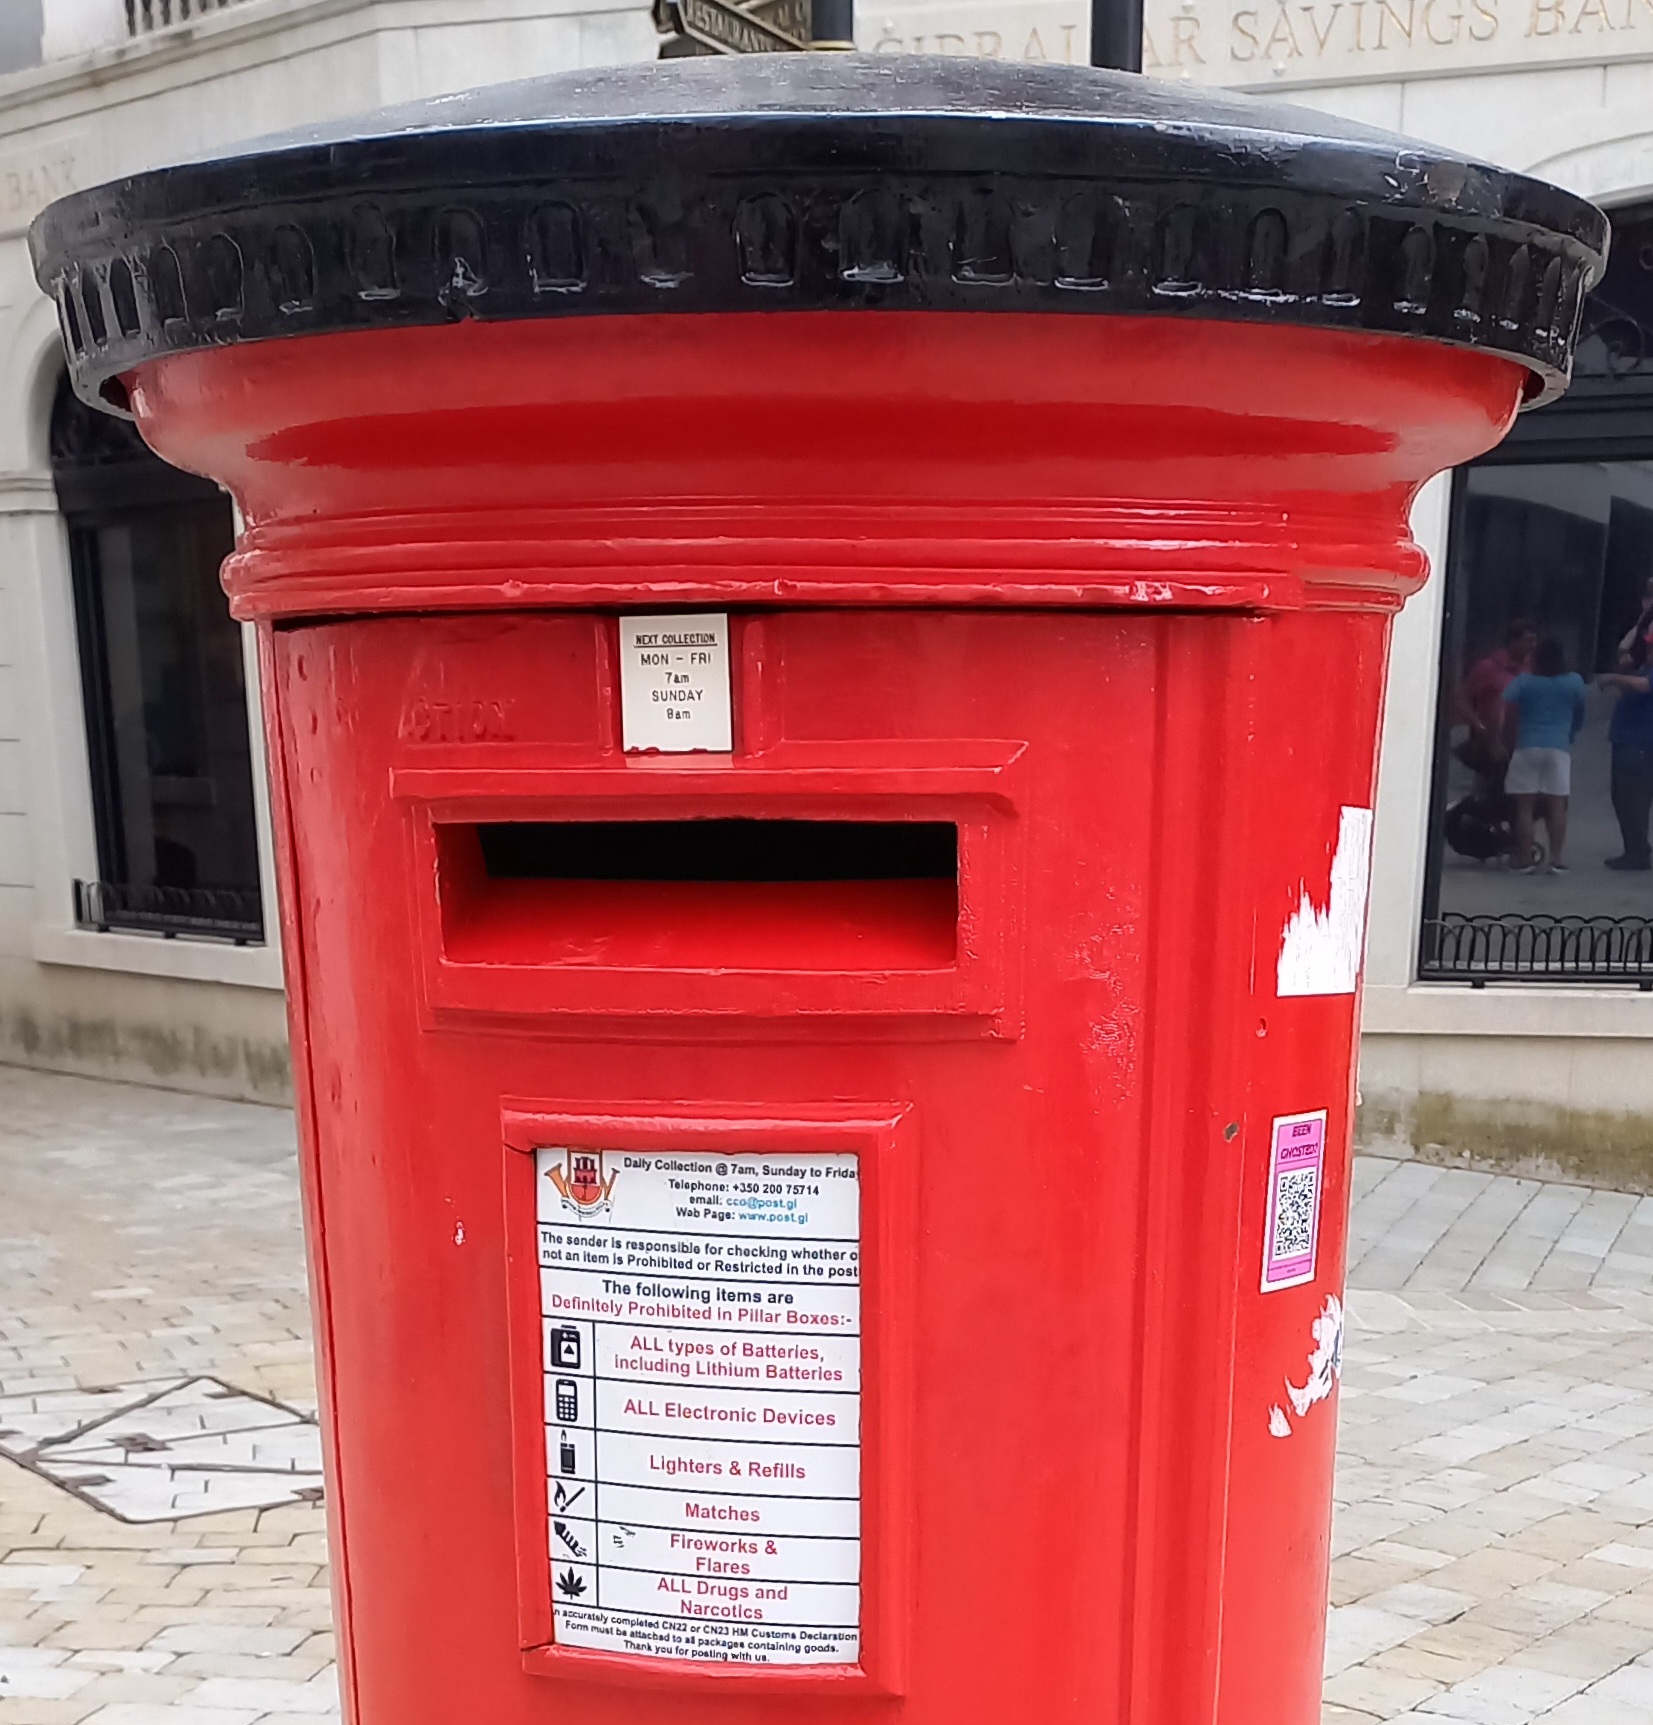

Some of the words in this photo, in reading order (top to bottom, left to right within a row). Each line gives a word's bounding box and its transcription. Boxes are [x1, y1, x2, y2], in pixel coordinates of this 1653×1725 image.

[1230, 0, 1498, 62] SAVINGS
[636, 634, 658, 645] NEXT
[662, 633, 716, 645] COLLECTION
[640, 653, 669, 666] MON
[690, 652, 711, 665] FRI
[665, 672, 690, 684] 7am
[651, 689, 704, 703] SUNDAY
[666, 708, 691, 720] 8am
[624, 1157, 651, 1171] Daily
[655, 1159, 712, 1173] Collection
[716, 1163, 728, 1175] @
[731, 1163, 759, 1176] 7am,
[762, 1165, 806, 1179] Sunday
[810, 1168, 821, 1177] to
[825, 1167, 857, 1180] Frida
[668, 1179, 729, 1192] Telephone:
[733, 1183, 759, 1193] +350
[763, 1184, 782, 1194] 200
[786, 1185, 819, 1195] 75714
[690, 1195, 723, 1205] email:
[676, 1206, 700, 1217] Web
[704, 1209, 735, 1221] Page:
[541, 1231, 562, 1244] The
[567, 1235, 608, 1248] sender
[612, 1237, 622, 1249] is
[626, 1240, 700, 1254] responsible
[705, 1243, 723, 1255] for
[727, 1245, 787, 1261] checking
[791, 1248, 846, 1260] whether
[543, 1250, 562, 1260] not
[566, 1253, 579, 1262] an
[584, 1251, 609, 1264] item
[613, 1253, 623, 1265] is
[628, 1255, 693, 1269] Prohibited
[697, 1261, 711, 1270] or
[715, 1260, 782, 1274] Restricted
[787, 1263, 799, 1275] in
[803, 1264, 823, 1275] the
[829, 1265, 858, 1278] post
[602, 1280, 631, 1295] The
[636, 1281, 710, 1304] following
[716, 1286, 762, 1303] items
[767, 1292, 793, 1305] are
[552, 1294, 623, 1316] Definitely
[629, 1302, 712, 1321] Prohibited
[718, 1308, 732, 1322] in
[738, 1308, 781, 1324] Pillar
[630, 1335, 663, 1352] ALL
[668, 1339, 714, 1359] types
[720, 1341, 737, 1356] of
[743, 1342, 824, 1363] Batteries,
[614, 1355, 690, 1377] including
[696, 1361, 760, 1379] Lithium
[766, 1364, 843, 1381] Batteries
[624, 1398, 660, 1416] ALL
[665, 1402, 757, 1423] Electronic
[763, 1407, 836, 1426] Devices
[650, 1455, 722, 1475] Lighters
[729, 1461, 742, 1476] &
[748, 1462, 806, 1479] Refills
[685, 1502, 760, 1521] Matches
[670, 1533, 758, 1555] Fireworks
[765, 1540, 778, 1555] &
[696, 1557, 751, 1575] Flares
[657, 1577, 692, 1595] ALL
[697, 1581, 749, 1601] Drugs
[755, 1586, 788, 1601] and
[680, 1600, 763, 1620] Narcotics
[562, 1610, 608, 1624] accurately
[611, 1615, 659, 1628] completed
[662, 1621, 687, 1632] CN22
[703, 1625, 729, 1635] CN23
[732, 1627, 748, 1637] HM
[751, 1628, 797, 1639] Customs
[800, 1631, 857, 1641] Declaration
[565, 1620, 589, 1631] Form
[591, 1625, 613, 1635] must
[616, 1626, 627, 1636] be
[629, 1629, 670, 1642] attached
[672, 1635, 682, 1643] to
[685, 1635, 695, 1643] all
[698, 1638, 744, 1649] packages
[748, 1641, 801, 1653] containing
[804, 1644, 839, 1654] goods.
[623, 1640, 652, 1651] Thank
[655, 1644, 672, 1655] you
[675, 1646, 689, 1656] for
[691, 1649, 727, 1662] posting
[731, 1651, 752, 1661] with
[755, 1654, 769, 1662] us.
